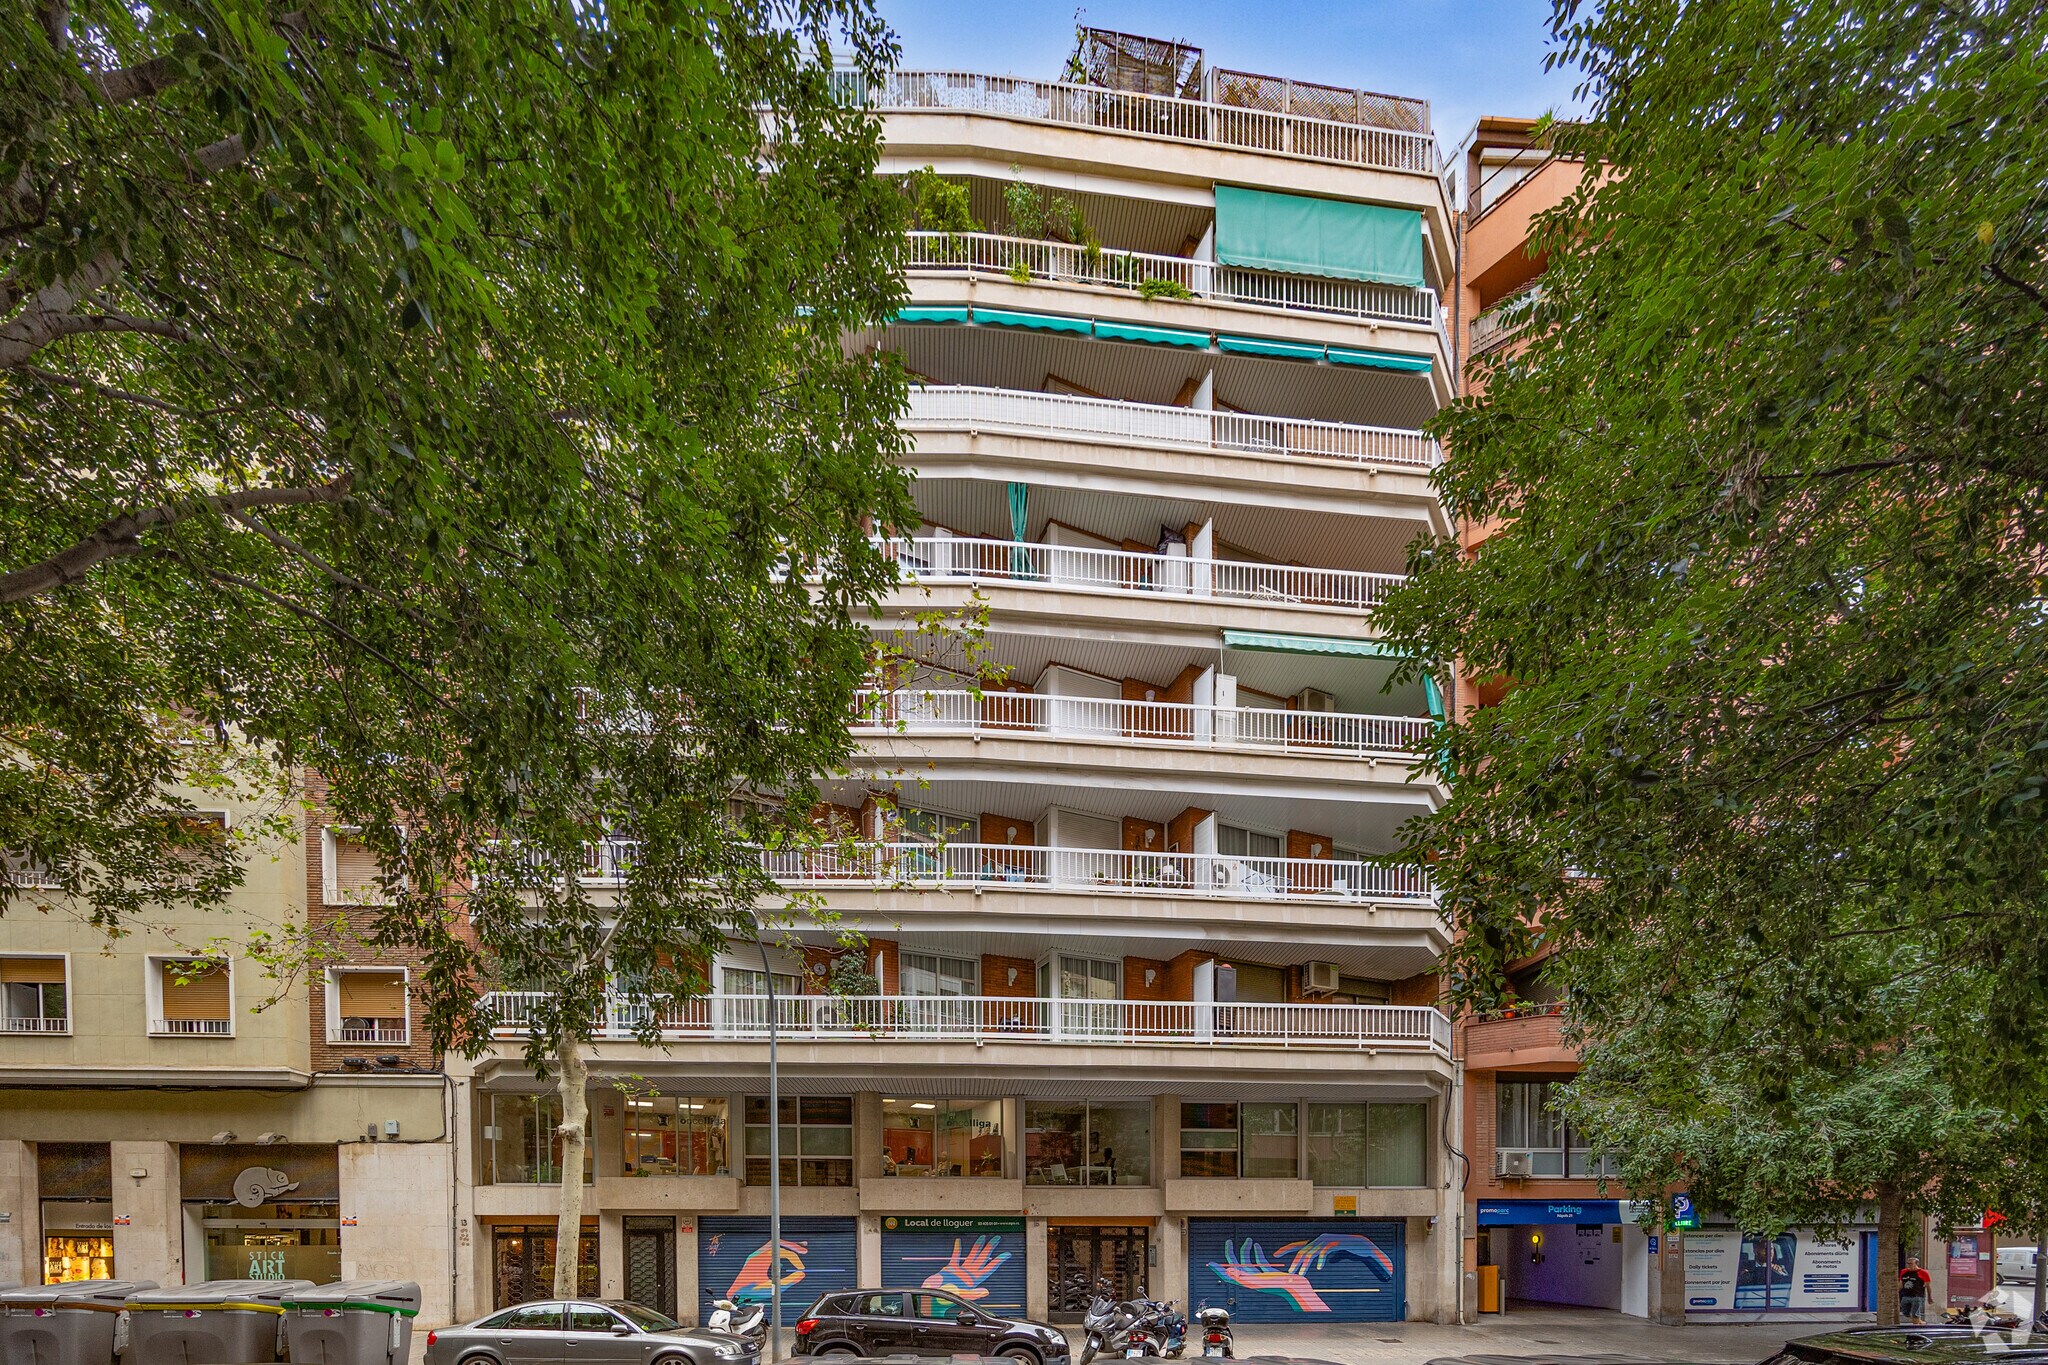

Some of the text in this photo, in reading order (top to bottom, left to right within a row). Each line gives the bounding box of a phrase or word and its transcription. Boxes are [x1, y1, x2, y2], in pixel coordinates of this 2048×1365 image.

[1548, 1205, 1582, 1215] Parking
[904, 1219, 929, 1227] Local
[930, 1219, 941, 1227] de
[943, 1219, 974, 1229] lloguer
[249, 1251, 285, 1260] STICK
[249, 1259, 286, 1274] ART
